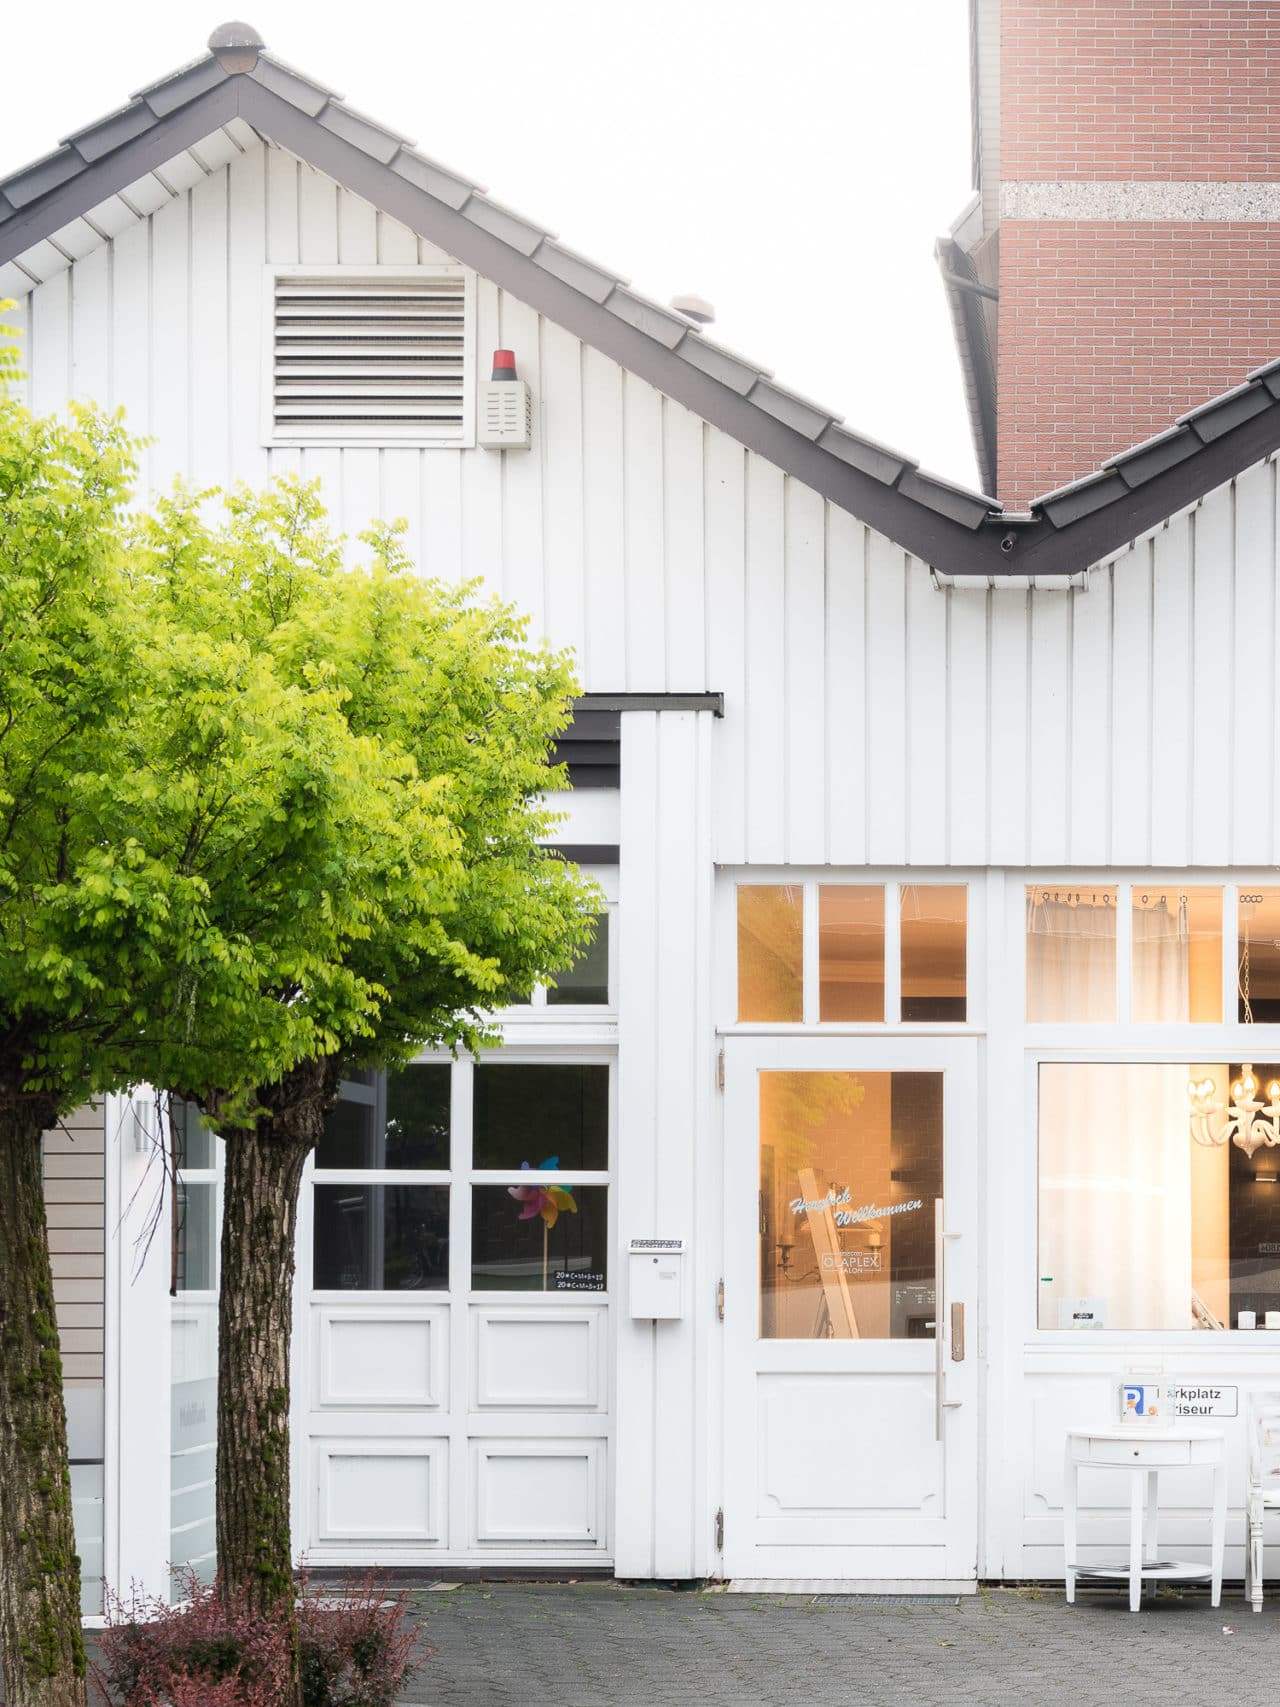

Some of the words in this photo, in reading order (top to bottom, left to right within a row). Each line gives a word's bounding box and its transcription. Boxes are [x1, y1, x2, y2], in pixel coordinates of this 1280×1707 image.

[834, 1199, 923, 1227] Willkommen
[1157, 1387, 1222, 1402] rkplatz
[1175, 1403, 1214, 1415] iseur
